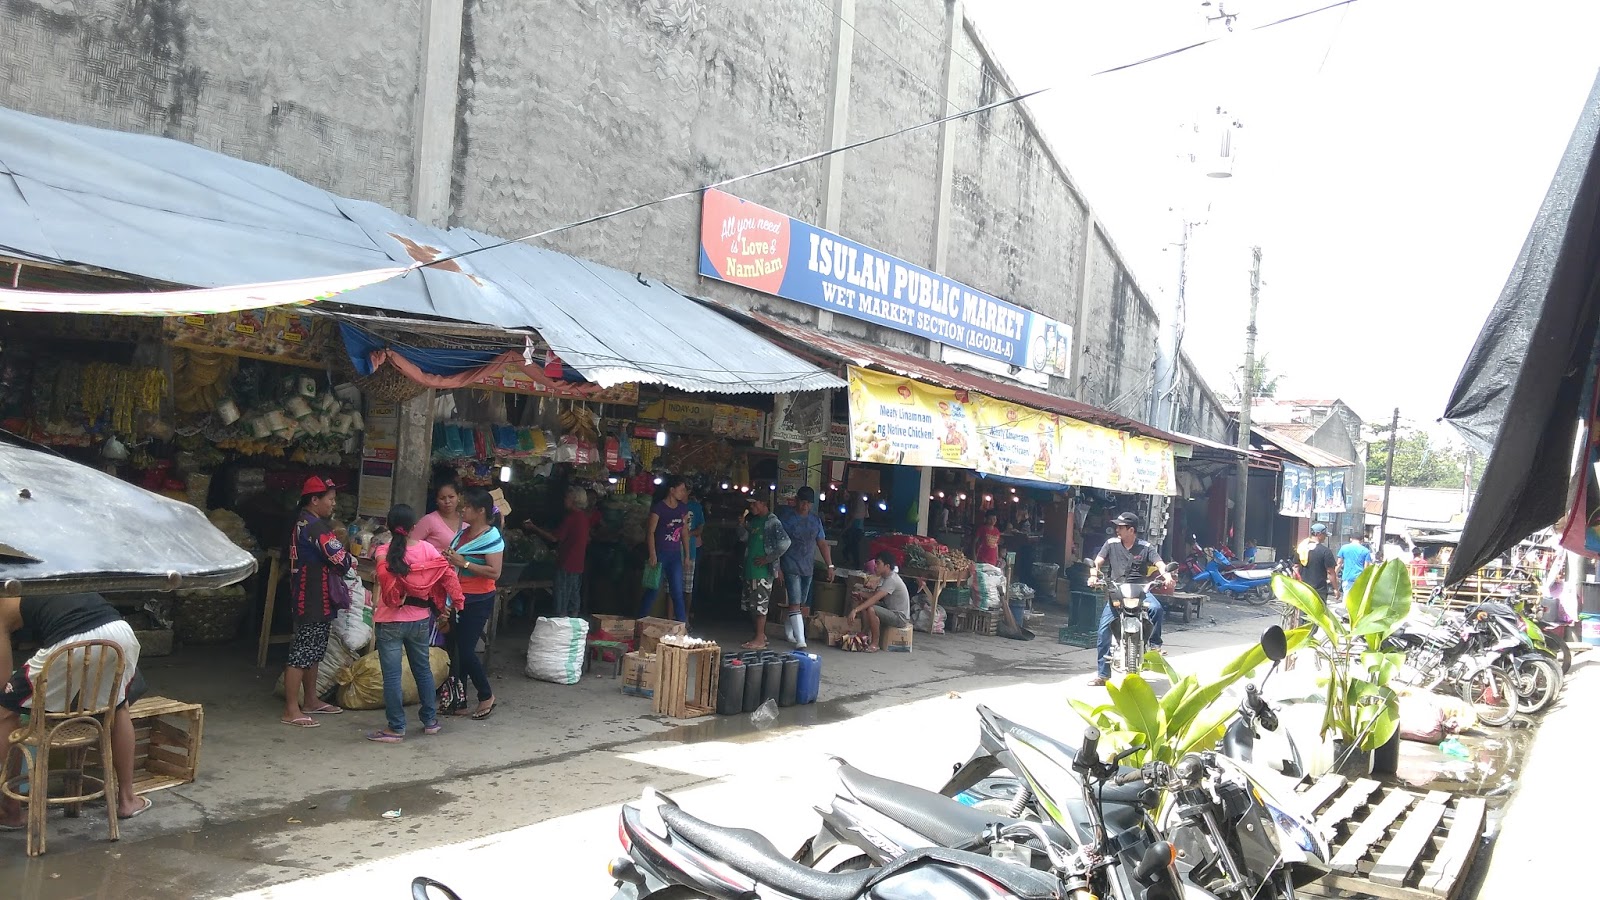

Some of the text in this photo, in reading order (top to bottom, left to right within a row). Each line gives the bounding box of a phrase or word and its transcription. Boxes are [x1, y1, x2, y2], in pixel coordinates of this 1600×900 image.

[721, 215, 781, 242] All you need
[730, 236, 777, 255] is Love &
[726, 256, 783, 278] NamNam
[808, 232, 1024, 341] ISULAN PUBLIC MARKET
[822, 280, 1014, 361] WET MARKET SECTION (AGORA-A)
[880, 404, 932, 423] Meaty Linamnam
[877, 423, 934, 440] ng Native Chicken!
[297, 565, 307, 616] YAMAHA
